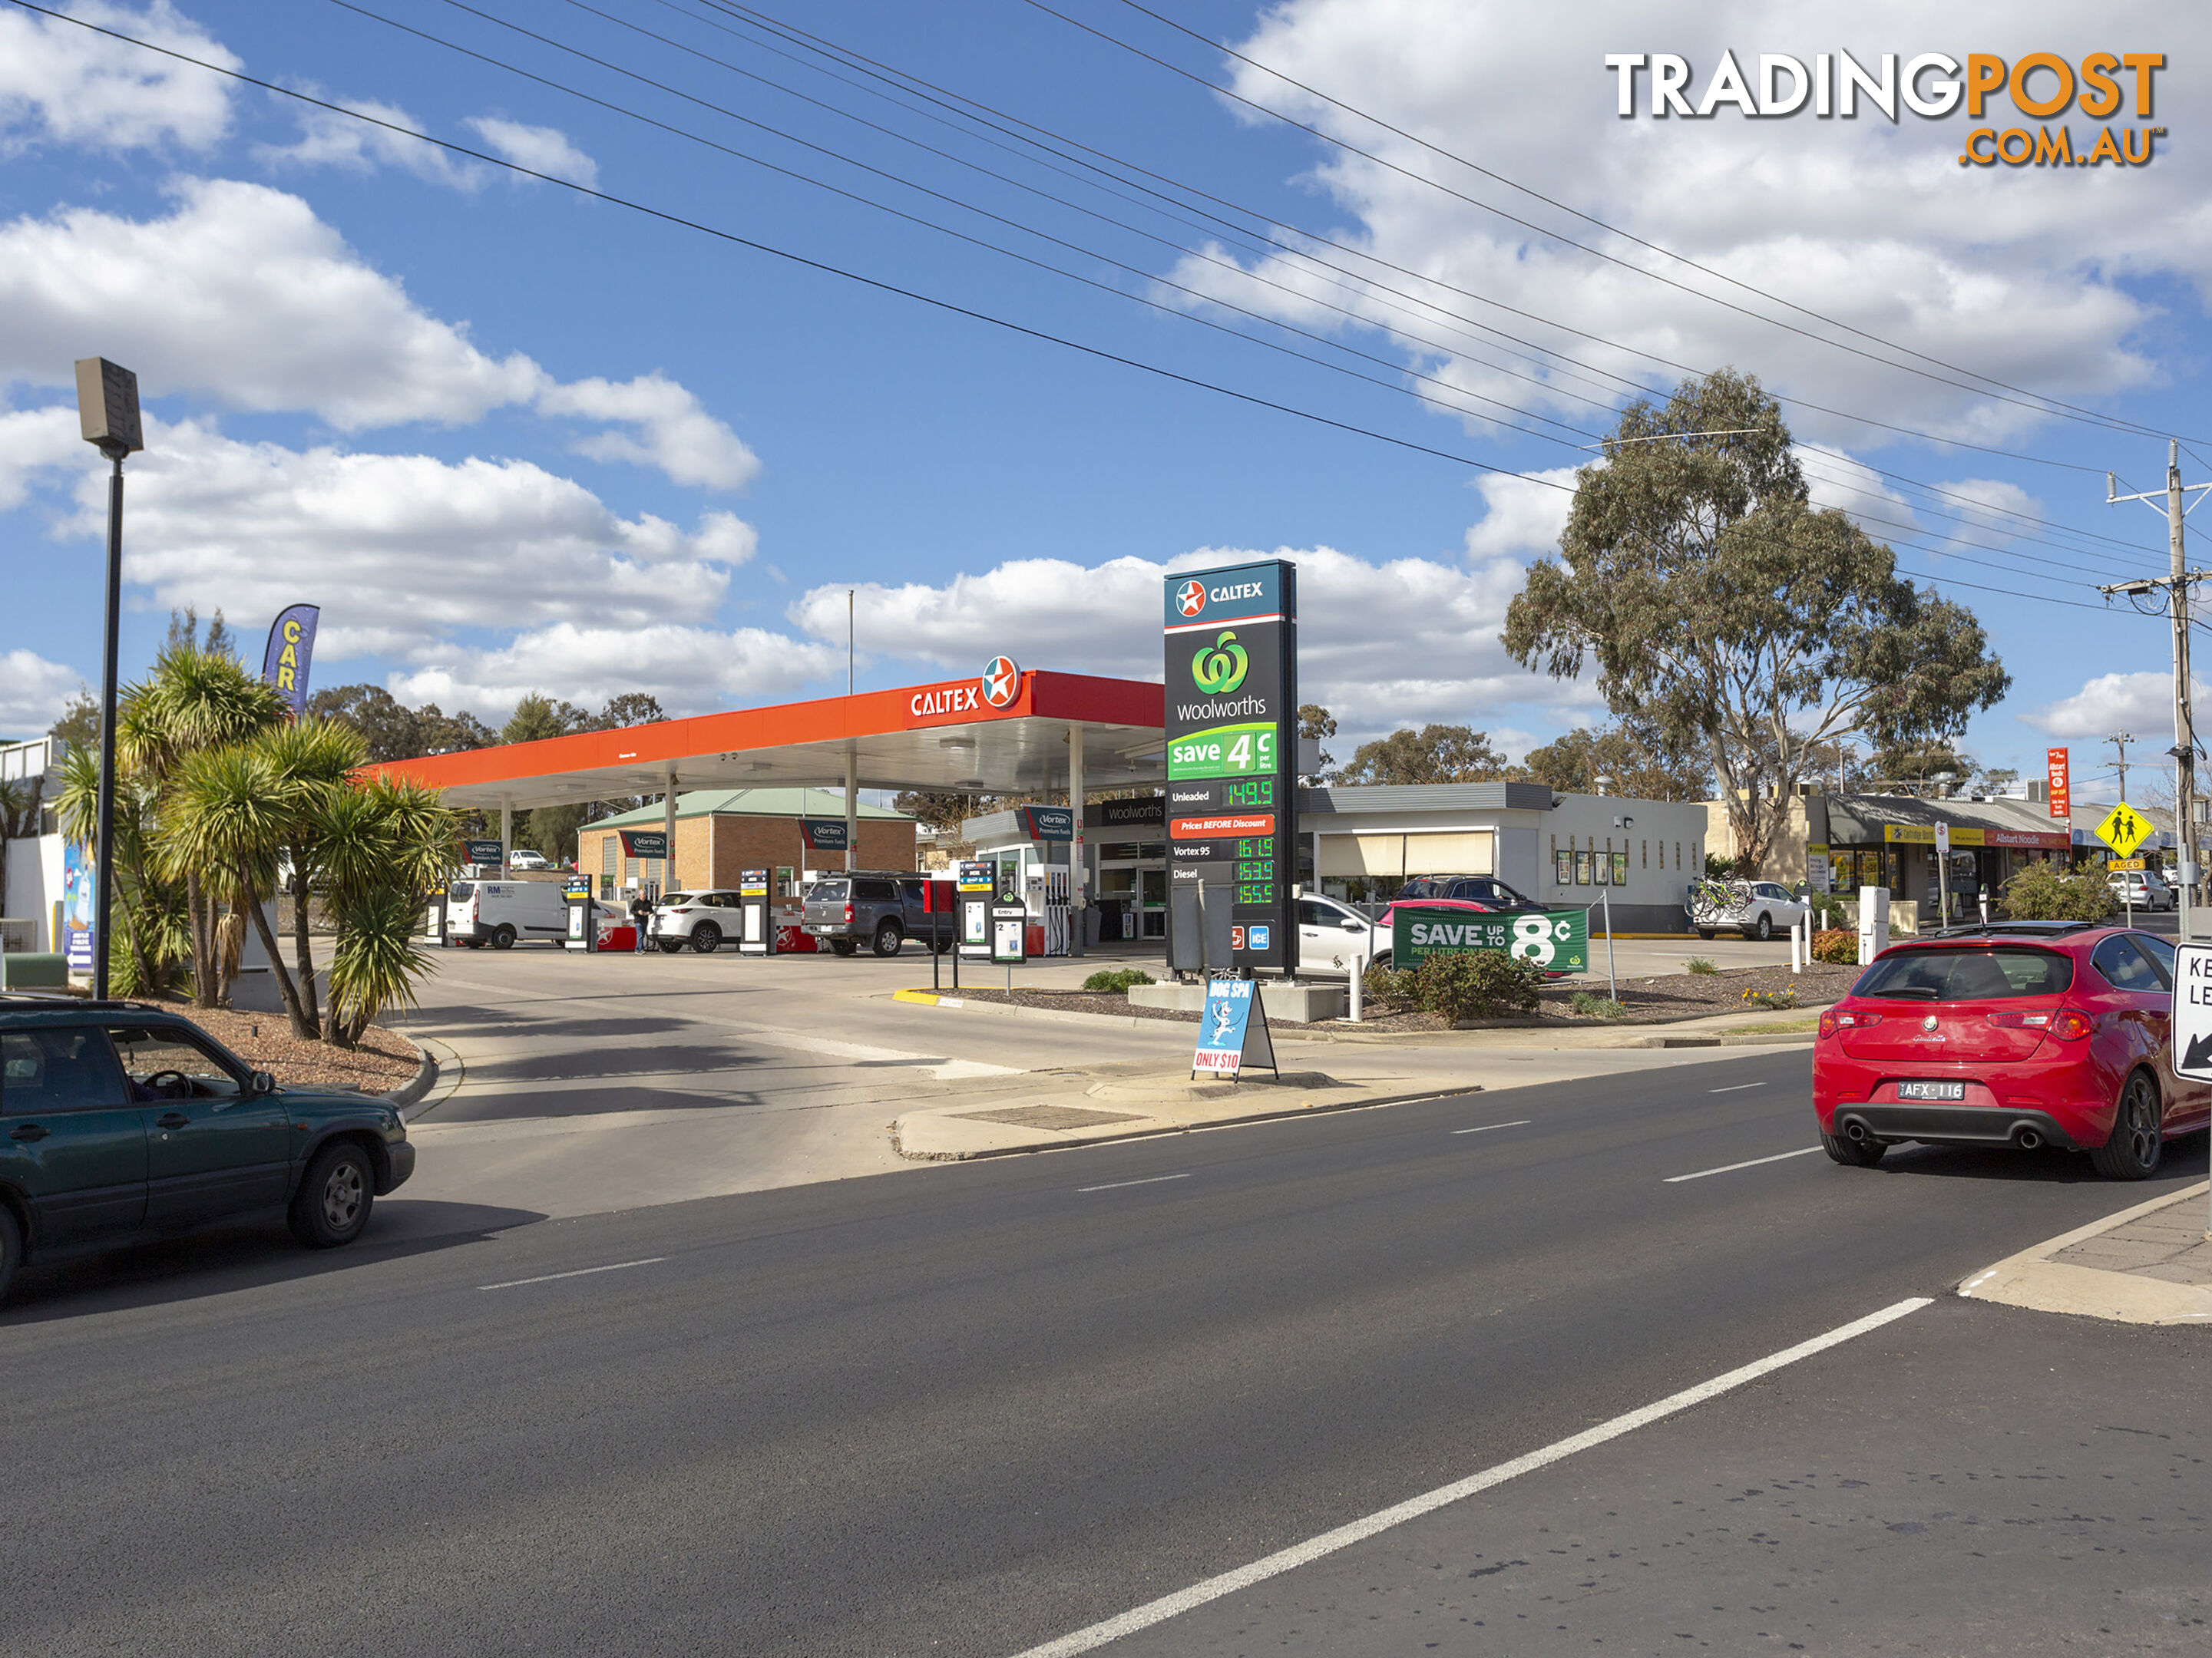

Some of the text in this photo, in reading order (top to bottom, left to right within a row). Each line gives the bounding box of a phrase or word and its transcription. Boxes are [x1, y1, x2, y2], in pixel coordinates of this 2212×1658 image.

[1210, 581, 1264, 603] CALTEX
[276, 619, 302, 692] CAR
[911, 686, 979, 716] CALTEX
[1177, 695, 1266, 722] Woolworths
[1173, 743, 1221, 764] save
[1227, 734, 1251, 769] 4
[1172, 781, 1272, 805] Unleaded 149.9
[1042, 814, 1067, 824] Vortex
[1109, 804, 1162, 819] Woolworths
[1181, 819, 1265, 831] Prices BEFORE Discount
[1996, 834, 2018, 844] Allstart
[2019, 835, 2040, 844] Noodle
[1173, 839, 1272, 857] Vortex 95 161.9
[1173, 861, 1272, 880] Diesel 153.9
[488, 886, 501, 894] RM
[1252, 933, 1267, 944] ICE
[1410, 923, 1505, 945] SAVE UP
[1486, 936, 1505, 946] TO
[1510, 914, 1555, 967] 8
[1411, 946, 1430, 956] PER
[1209, 983, 1250, 998] DOG SPA
[1196, 1052, 1238, 1068] ONLY $10
